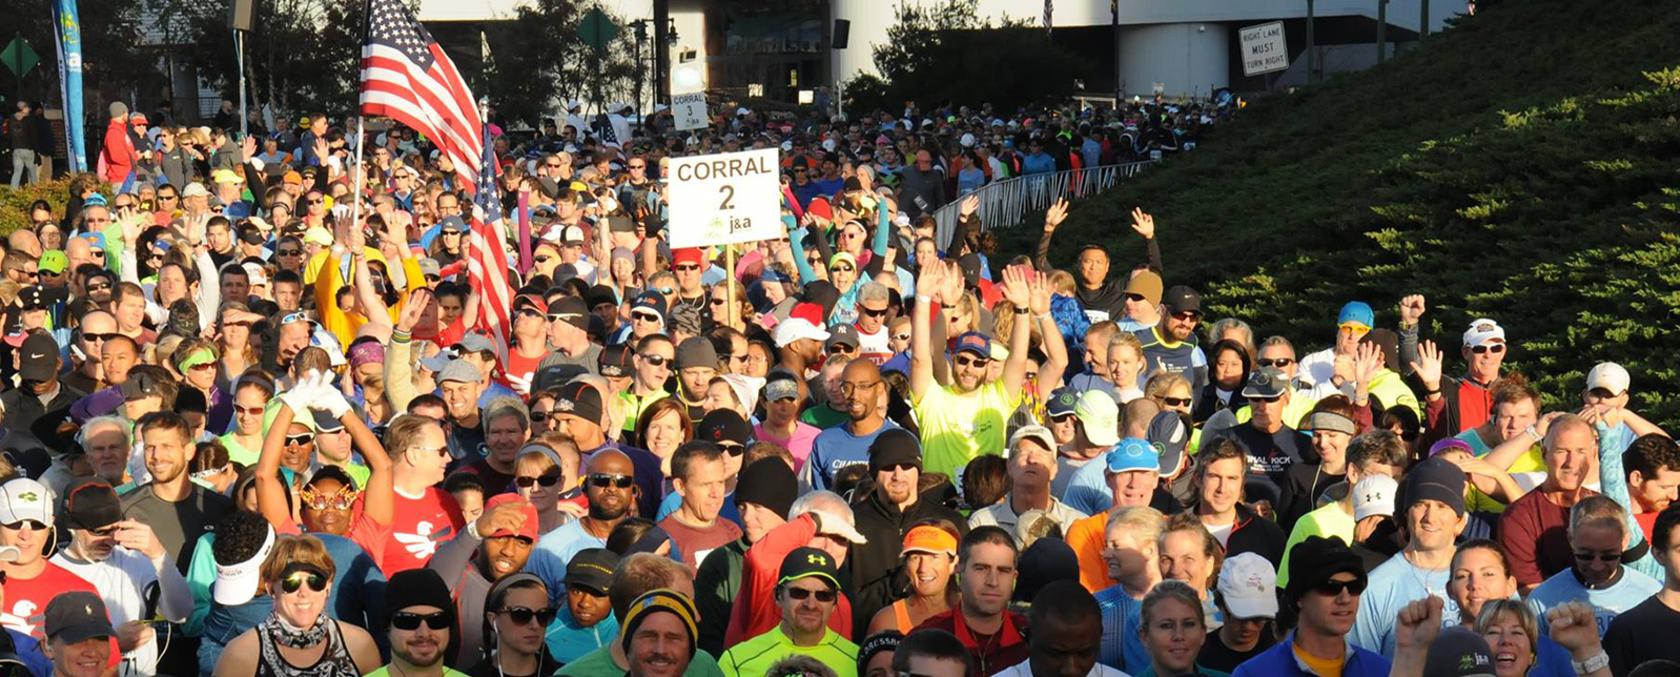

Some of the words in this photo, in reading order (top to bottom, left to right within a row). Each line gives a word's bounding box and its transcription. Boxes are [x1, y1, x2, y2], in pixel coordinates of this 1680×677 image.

[1243, 32, 1260, 42] RIGHT
[1263, 28, 1281, 39] LANE
[1252, 42, 1274, 54] MUST
[1247, 60, 1263, 69] TURN
[1265, 55, 1284, 65] RIGHT
[674, 94, 704, 104] CORRAL
[687, 105, 693, 116] 3
[677, 156, 772, 182] CORRAL
[719, 184, 735, 210] 2
[729, 215, 751, 234] j&a
[1271, 456, 1291, 465] KICK
